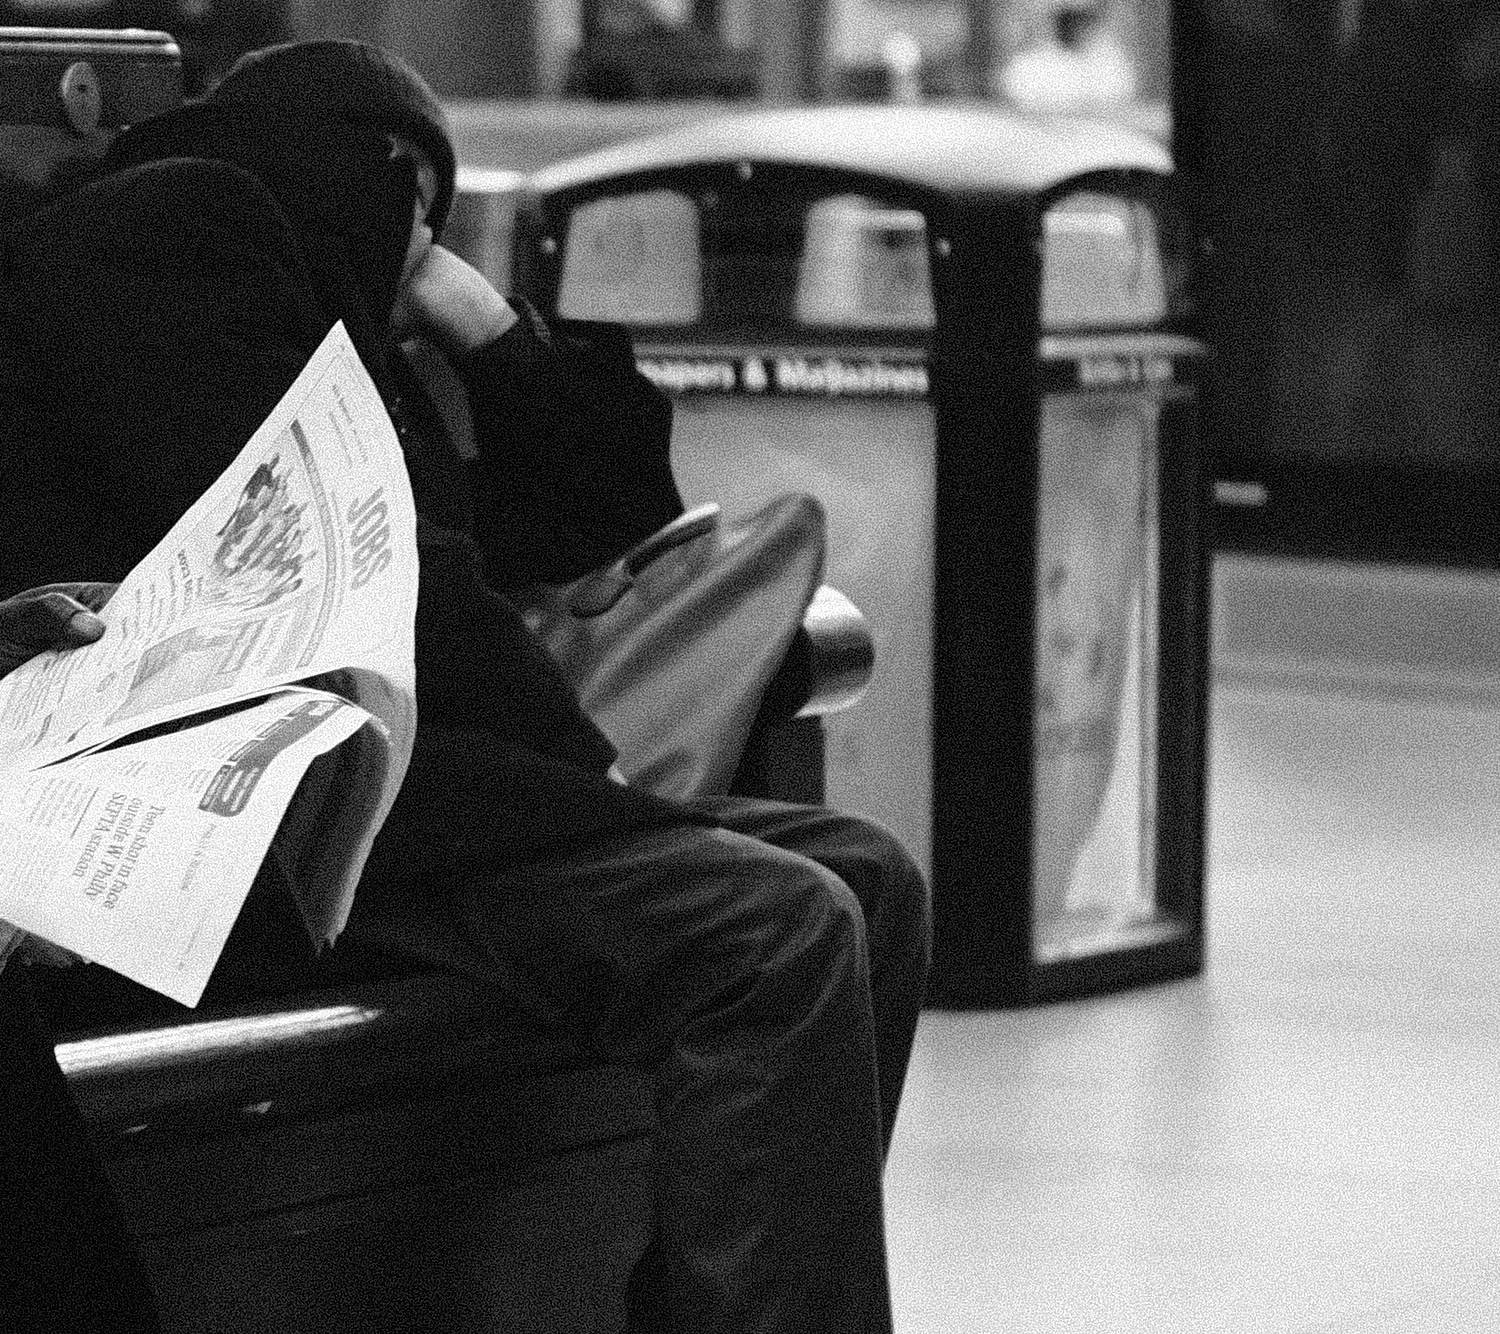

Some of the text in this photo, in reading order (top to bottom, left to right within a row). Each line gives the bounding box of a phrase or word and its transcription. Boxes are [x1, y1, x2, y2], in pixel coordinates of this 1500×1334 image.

[347, 485, 393, 591] JOBS
[140, 804, 167, 835] Teen
[103, 879, 128, 910] face
